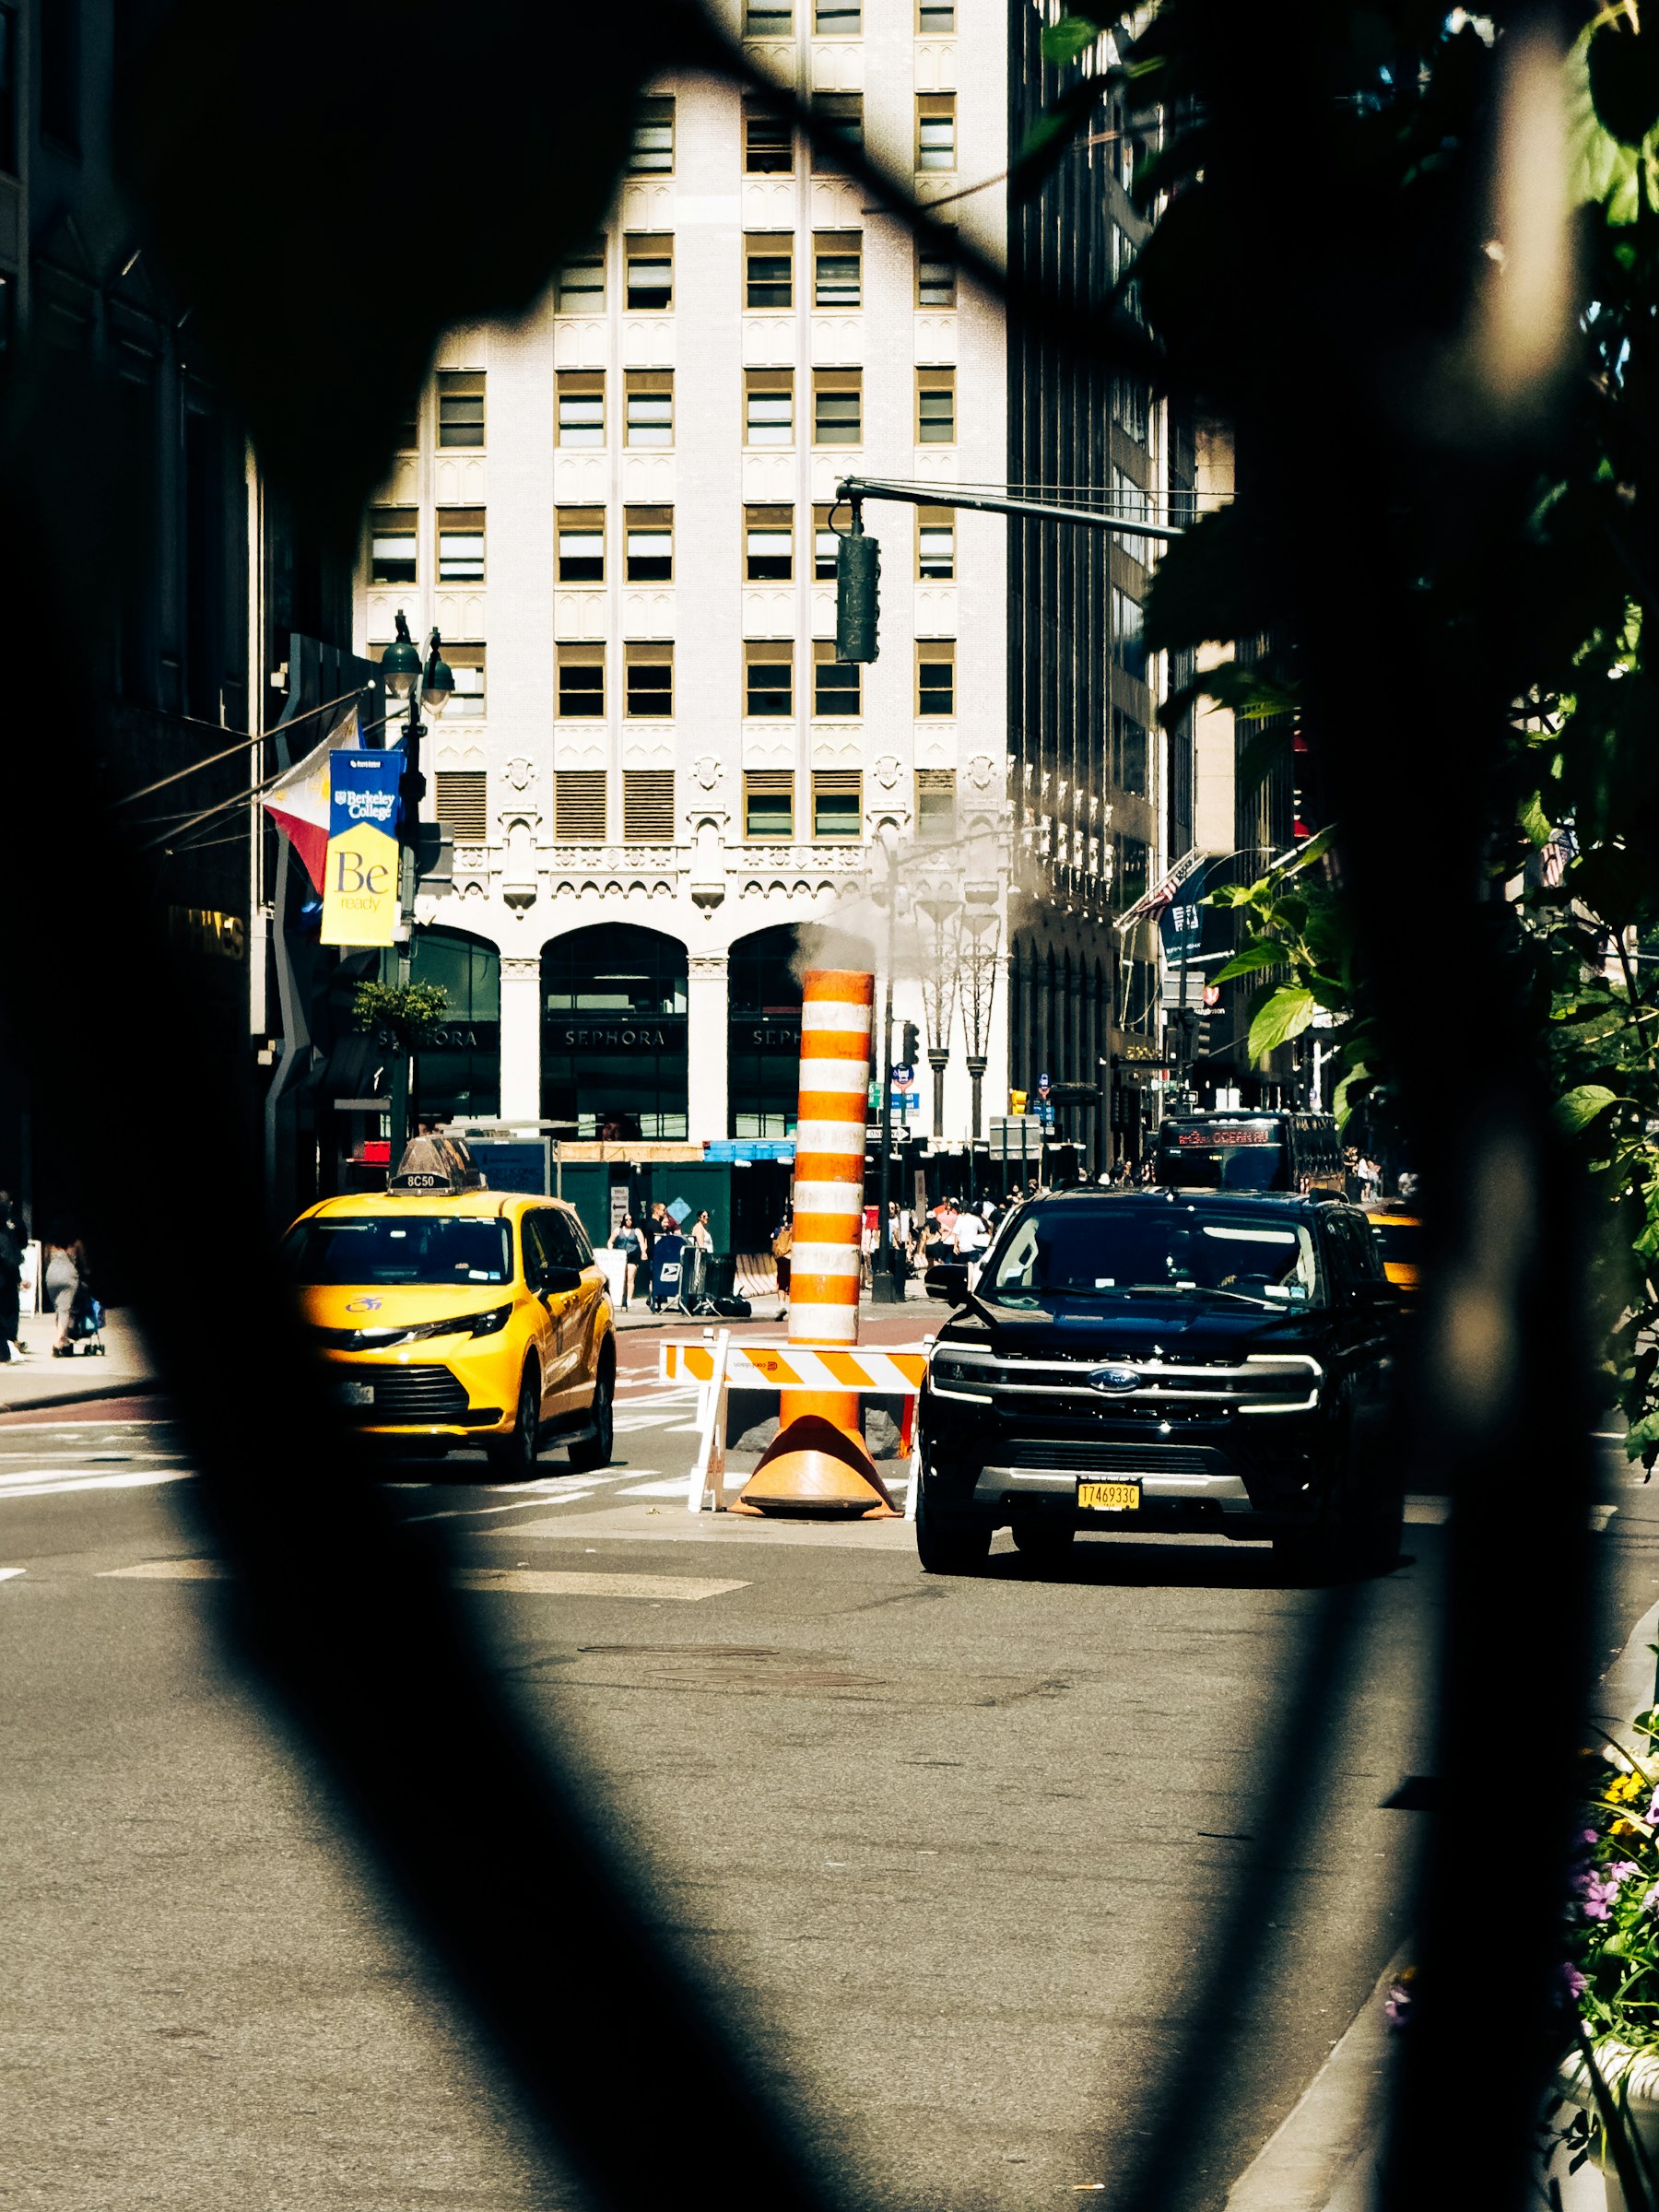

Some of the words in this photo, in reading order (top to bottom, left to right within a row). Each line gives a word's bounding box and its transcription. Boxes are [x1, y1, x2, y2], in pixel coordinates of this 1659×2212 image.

[347, 790, 395, 806] Berkeley
[348, 804, 393, 821] College
[334, 851, 389, 894] Be
[340, 898, 381, 912] ready
[565, 1030, 665, 1045] SEPHORA
[752, 1030, 801, 1045] SEPH
[407, 1176, 434, 1187] 8C50
[1082, 1486, 1135, 1504] T746933C
